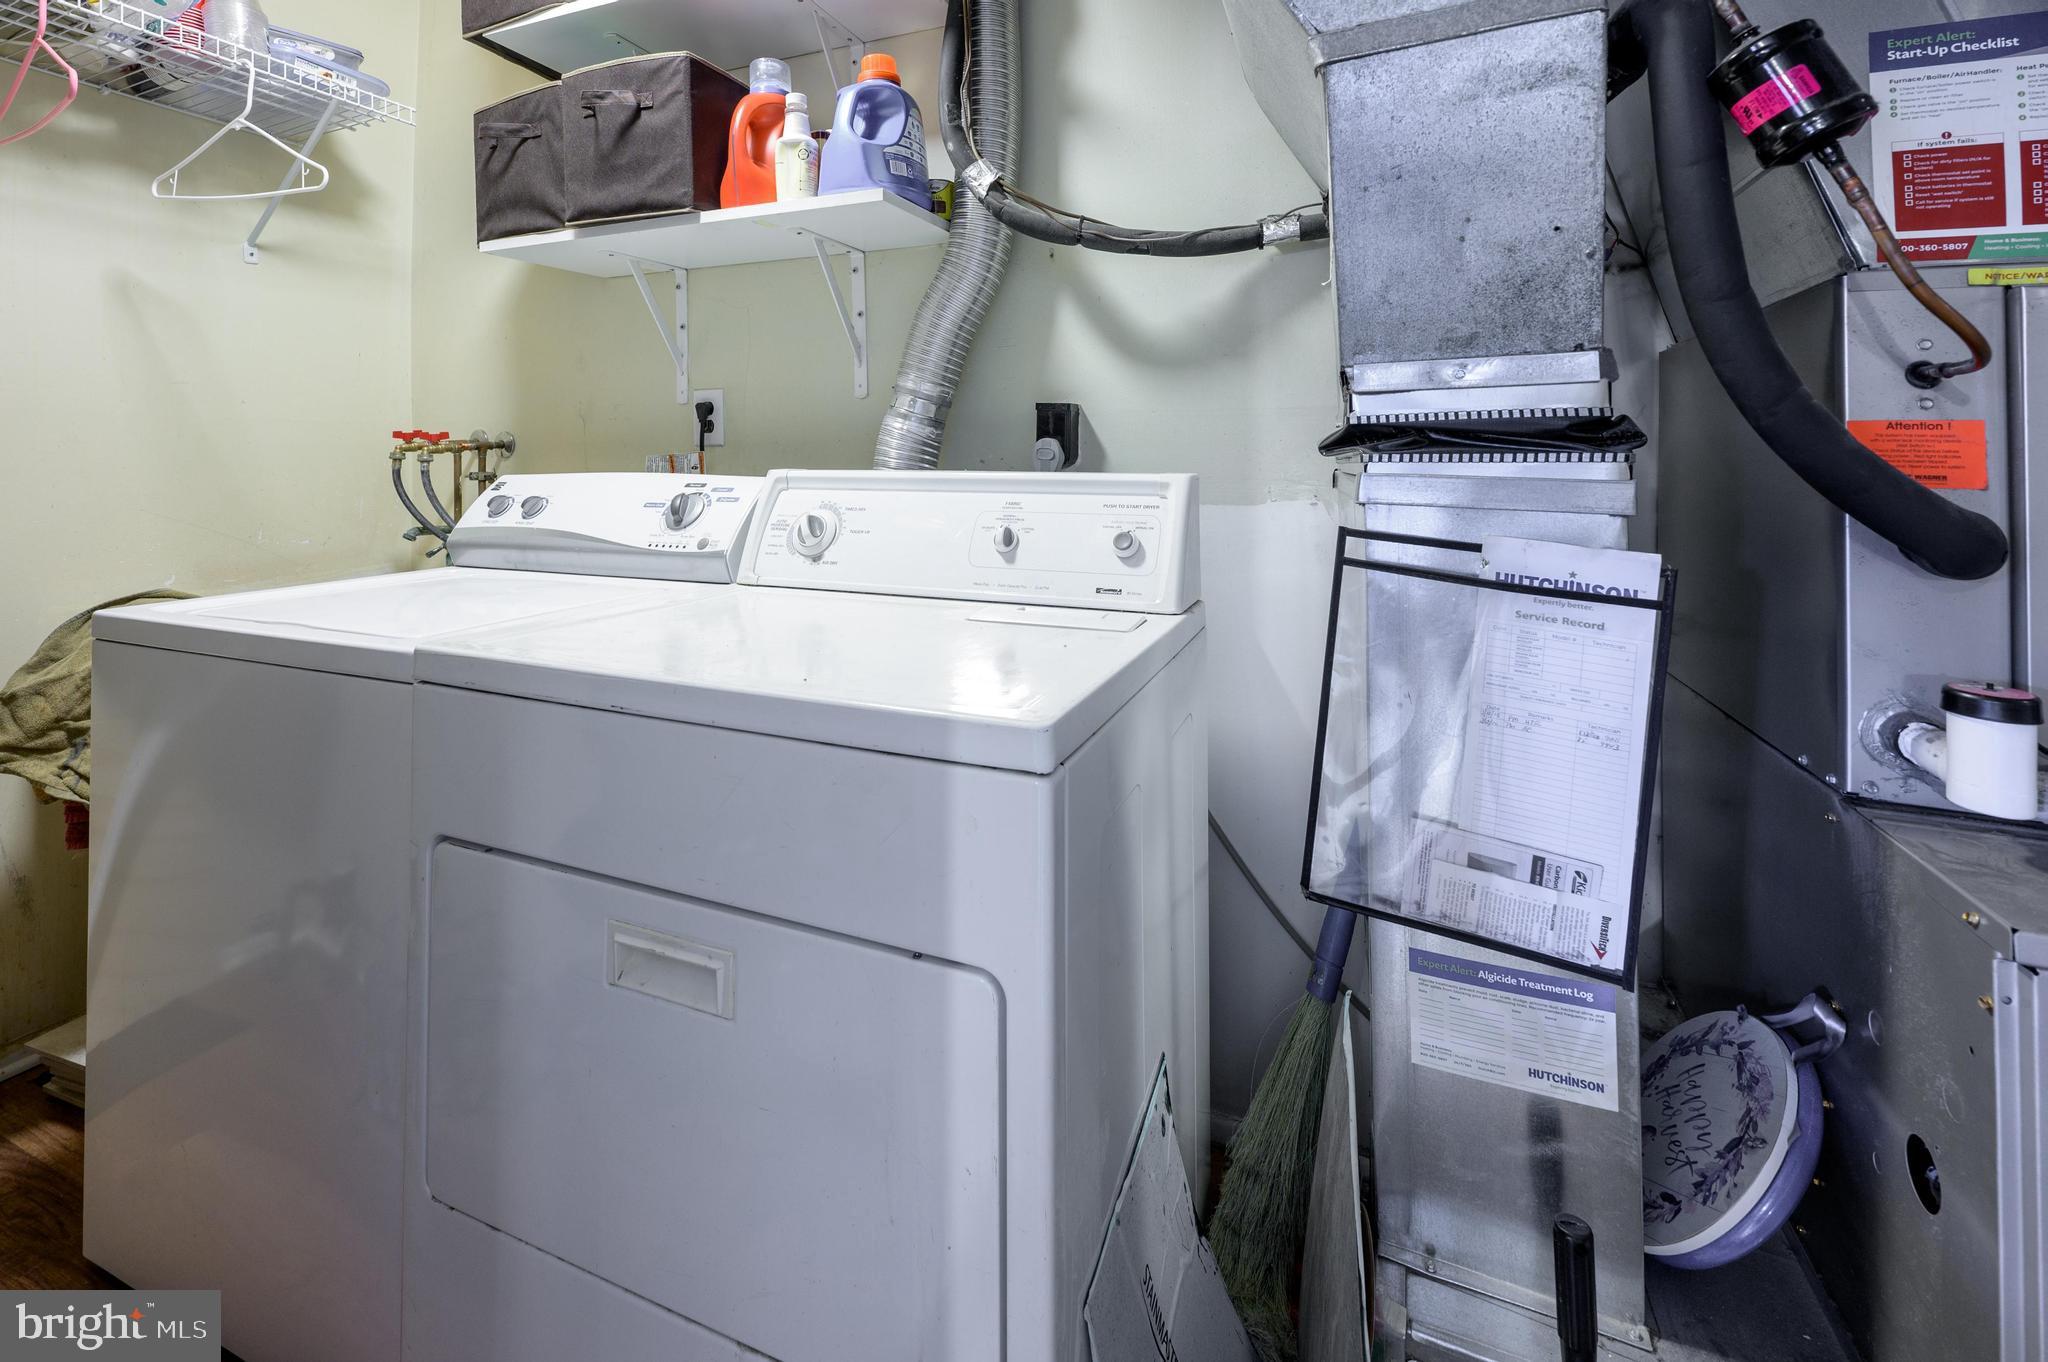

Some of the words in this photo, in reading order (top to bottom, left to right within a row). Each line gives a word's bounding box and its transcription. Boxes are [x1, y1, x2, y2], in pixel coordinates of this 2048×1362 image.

[1887, 35, 1933, 48] Expert
[1936, 31, 1976, 42] Alert:
[1887, 45, 1948, 60] Start-Up
[1951, 37, 2020, 52] Checklist
[1925, 139, 1955, 147] system
[1886, 422, 1943, 431] Attention
[1515, 610, 1558, 624] Service
[1562, 617, 1605, 631] Record
[1417, 957, 1449, 972] Expert
[1449, 964, 1477, 977] Alert:
[1478, 970, 1518, 985] Algicide
[1519, 977, 1573, 996] Treatment
[1574, 989, 1594, 1003] Log
[1528, 1067, 1605, 1093] HUTCHINSON
[1675, 1062, 1714, 1157] Happy
[1655, 1083, 1700, 1177] Harvest
